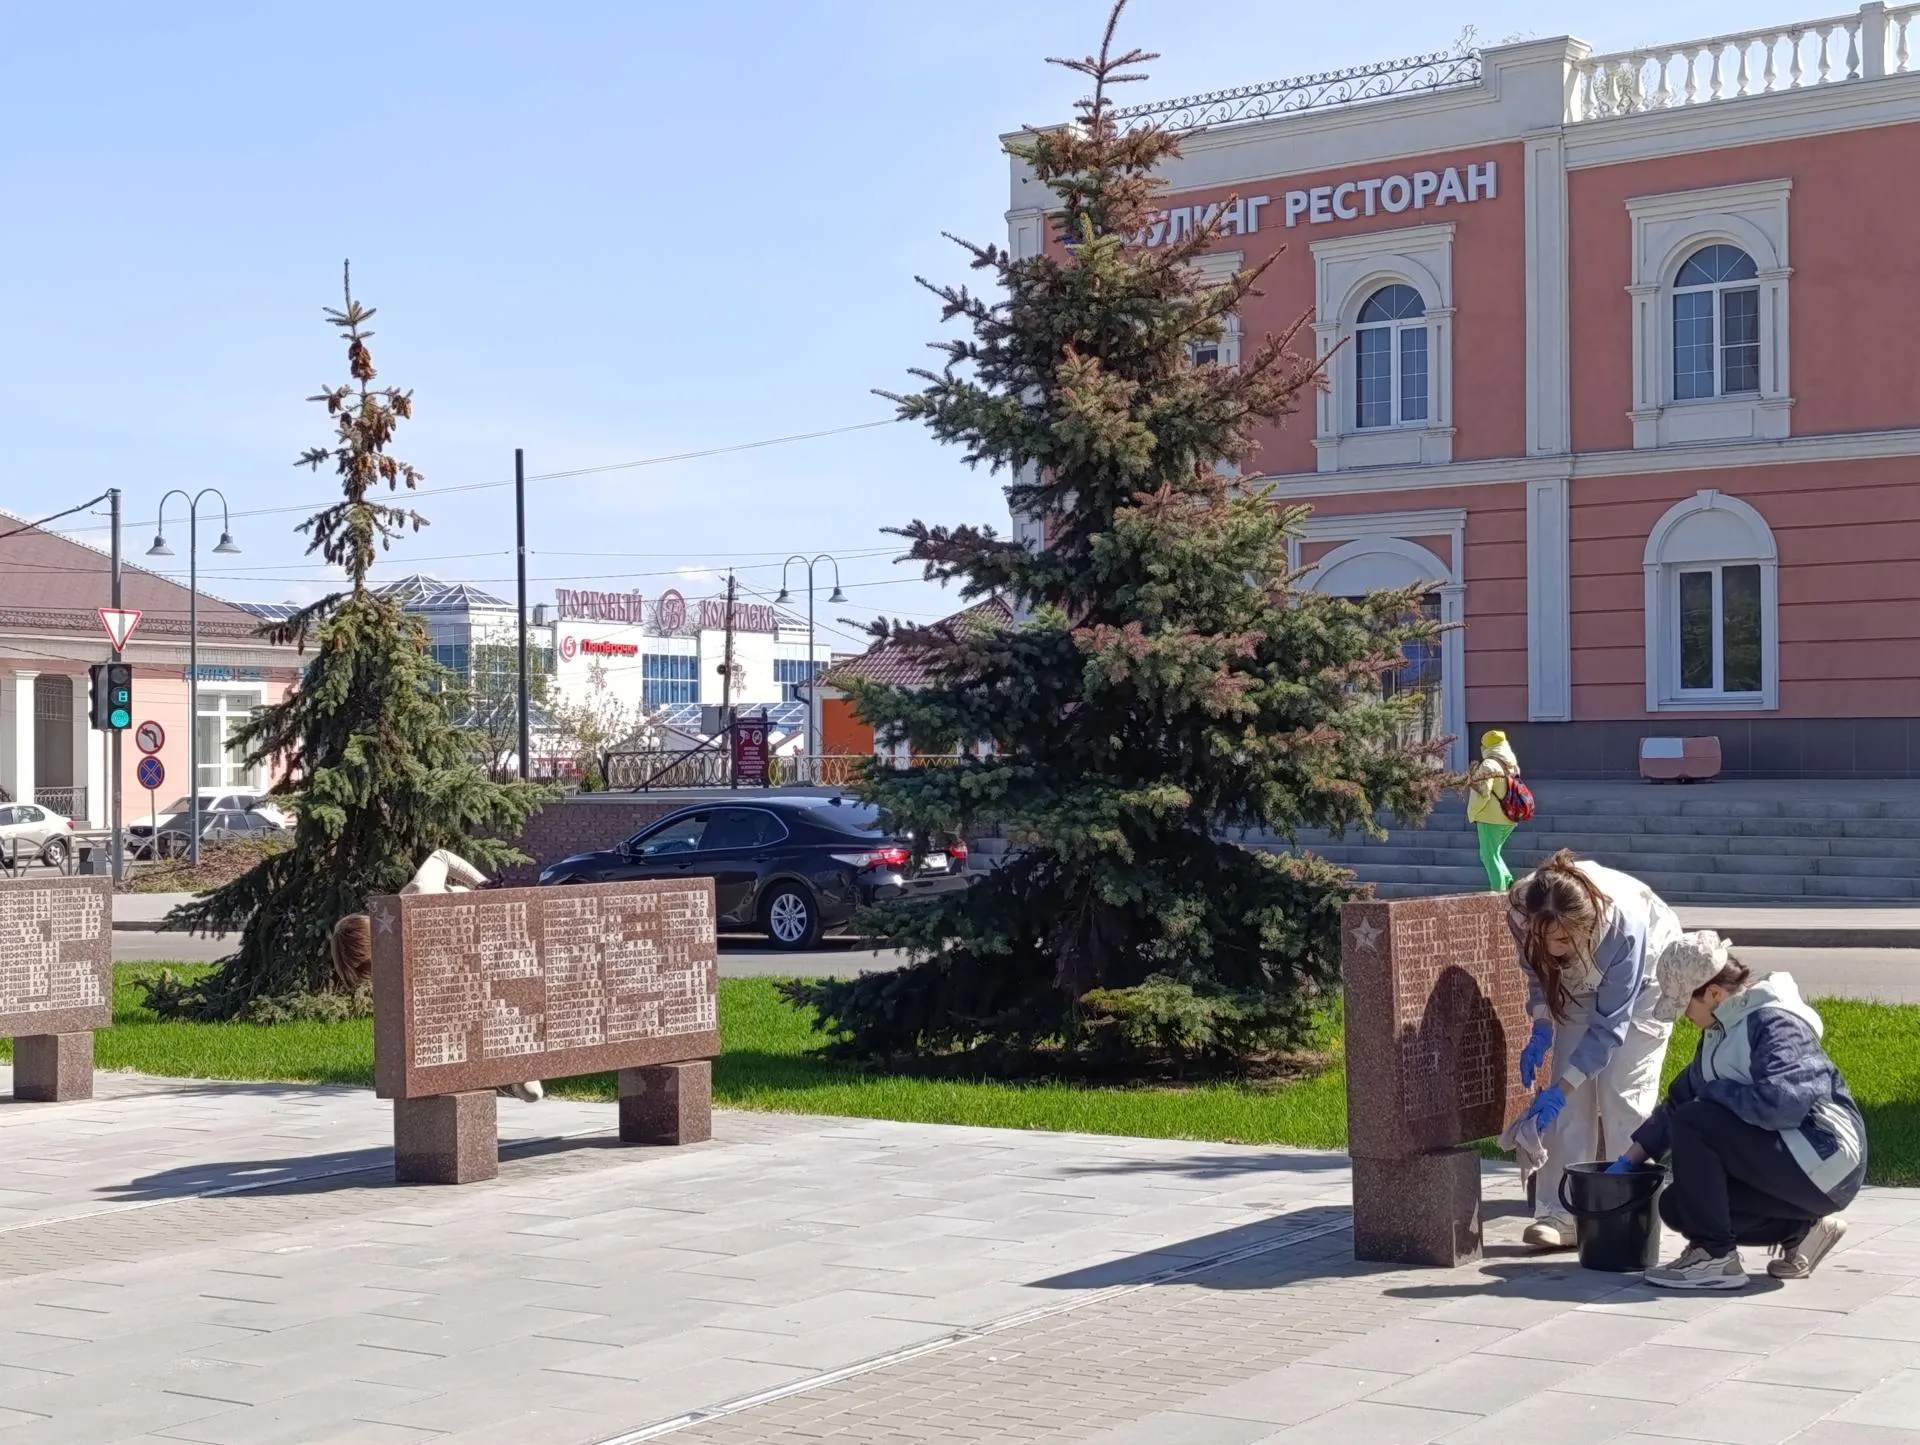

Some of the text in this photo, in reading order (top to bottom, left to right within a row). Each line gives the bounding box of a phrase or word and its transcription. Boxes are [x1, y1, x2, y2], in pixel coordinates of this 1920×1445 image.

[1125, 161, 1498, 247] УЛИНГ РЕСТОРАН
[555, 588, 643, 623] ТОРГОВЫЙ
[480, 904, 505, 914] ОРЛОВ
[665, 1014, 697, 1025] РОМАНОВ
[415, 1035, 442, 1046] ОРЛОВ
[415, 1044, 442, 1056] ОРЛОВ
[415, 1054, 442, 1066] ОРЛОВ
